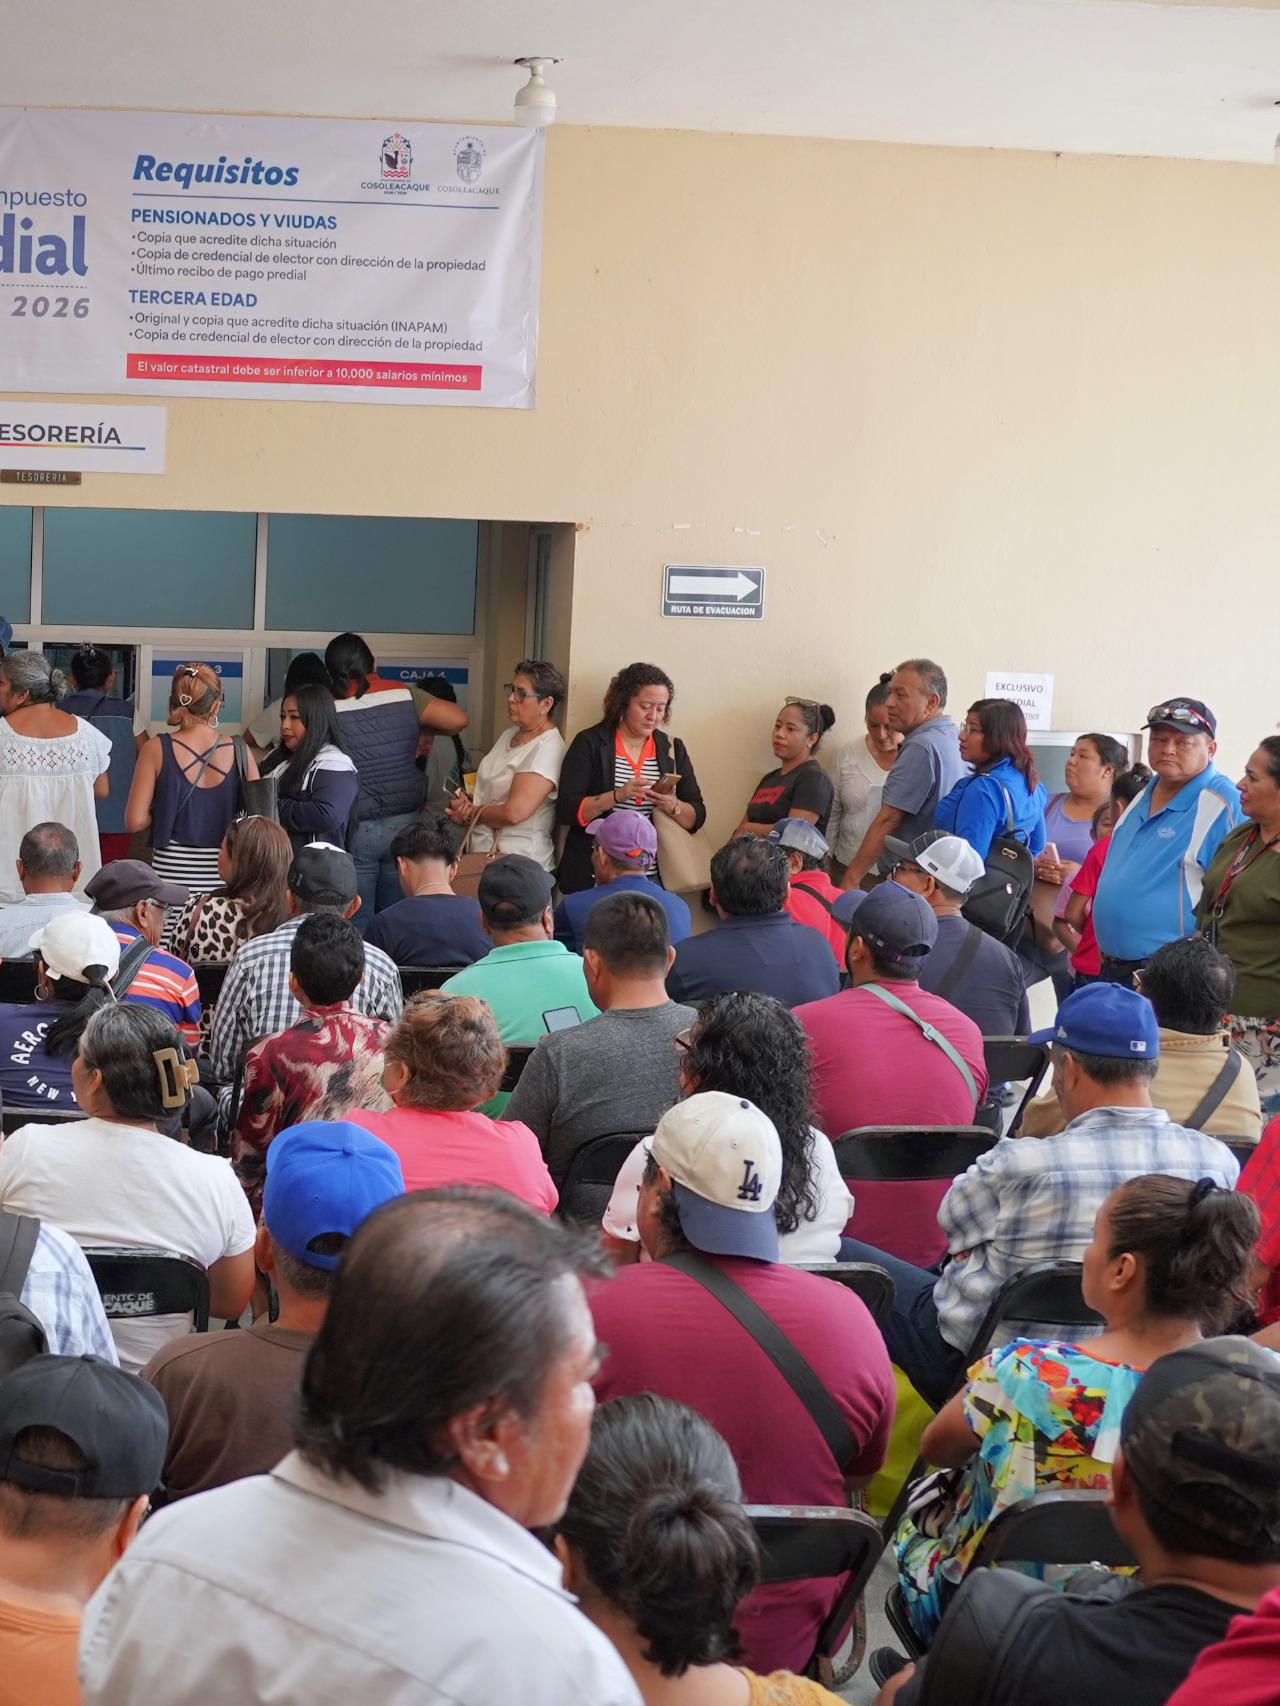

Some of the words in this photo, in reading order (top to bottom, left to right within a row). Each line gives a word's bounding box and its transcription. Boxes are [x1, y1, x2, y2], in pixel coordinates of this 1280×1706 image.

[133, 155, 299, 189] Requisitos
[361, 182, 430, 192] COSOLEACAQUE
[437, 185, 500, 195] COSOLEACAQUE
[132, 209, 256, 226] PENSIONADOS
[260, 213, 270, 227] Y
[274, 214, 336, 229] VIUDAS
[137, 231, 171, 246] Copia
[174, 235, 196, 245] que
[199, 234, 247, 245] acredite
[250, 235, 281, 246] dicha
[284, 237, 336, 248] situación
[136, 248, 170, 262] Copia
[174, 249, 188, 260] de
[191, 251, 252, 261] credencial
[255, 252, 270, 262] de
[272, 252, 314, 264] elector
[316, 256, 337, 265] con
[340, 255, 393, 267] dirección
[396, 257, 411, 268] de
[414, 258, 423, 269] la
[426, 259, 485, 271] propiedad
[136, 262, 174, 275] Último
[178, 266, 214, 276] recibo
[217, 267, 232, 277] de
[234, 270, 264, 281] pago
[267, 269, 306, 280] predial
[10, 296, 89, 318] 2026
[128, 290, 206, 305] TERCERA
[211, 292, 257, 307] EDAD
[134, 313, 180, 326] Original
[183, 316, 189, 326] y
[192, 314, 223, 327] copia
[226, 318, 248, 329] que
[251, 317, 299, 328] acredite
[302, 318, 333, 329] dicha
[336, 320, 388, 330] situación
[391, 321, 447, 333] (INAPAM)
[134, 328, 168, 341] Copia
[171, 330, 186, 340] de
[189, 331, 249, 342] credencial
[252, 332, 267, 343] de
[270, 333, 311, 344] elector
[313, 337, 334, 345] con
[338, 336, 391, 347] dirección
[394, 337, 409, 348] de
[412, 338, 421, 348] la
[424, 339, 482, 351] propiedad
[138, 361, 147, 371] El
[150, 362, 178, 372] valor
[180, 364, 229, 374] catastral
[232, 364, 260, 375] debe
[284, 366, 324, 376] inferior
[336, 368, 373, 379] 10,000
[376, 370, 417, 380] salarios
[420, 371, 467, 382] mínimos
[16, 471, 67, 483] TESORERIA
[671, 605, 691, 613] RUTA
[693, 606, 704, 614] DE
[706, 606, 755, 615] EVACUACION
[400, 670, 434, 680] CAJA
[995, 683, 1043, 693] EXCLUSIVO
[27, 1075, 59, 1100] NEW
[737, 1159, 762, 1201] LA
